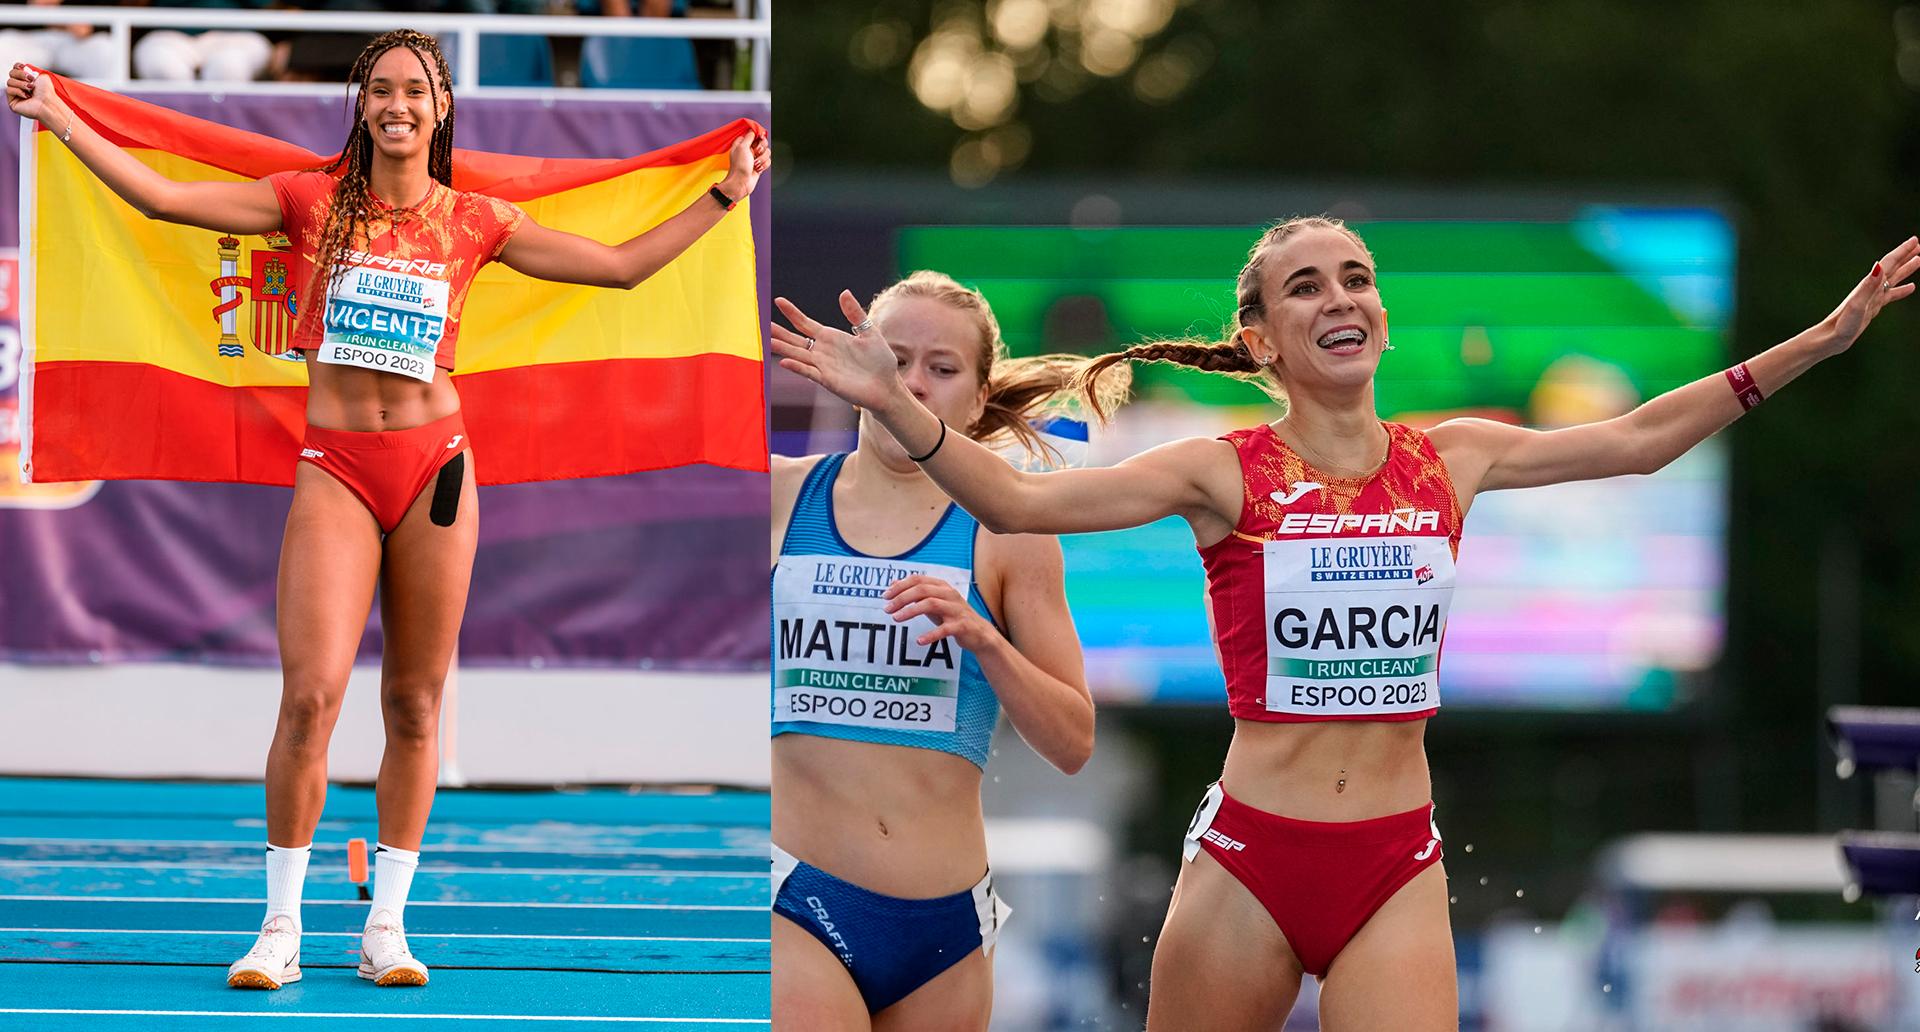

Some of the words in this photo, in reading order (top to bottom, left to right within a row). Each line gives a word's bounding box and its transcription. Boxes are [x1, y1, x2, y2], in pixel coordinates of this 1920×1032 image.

[358, 273, 372, 287] LE
[374, 274, 424, 296] GRUYÈRE
[359, 287, 419, 302] SWITZERLAND
[330, 305, 440, 345] VICENTE
[351, 334, 376, 346] RUN
[334, 347, 387, 365] ESPOO
[390, 356, 424, 375] 2023
[1276, 508, 1440, 534] ESPAÑA
[1311, 547, 1333, 568] LE
[1336, 541, 1413, 568] GRUYÈRE
[814, 562, 836, 583] LE
[1314, 570, 1410, 580] SWITZERLAND
[816, 585, 882, 598] SWITZERL
[1273, 603, 1439, 650] GARCIA
[779, 617, 954, 670] MATTILA
[800, 670, 806, 684] I
[810, 671, 848, 688] RUN
[1317, 662, 1356, 677] RUN
[1291, 685, 1376, 707] ESPOO
[1382, 681, 1427, 705] 2023
[790, 693, 866, 718] ESPOO
[873, 700, 931, 722] 2023
[1202, 828, 1246, 851] ESP
[806, 896, 848, 950] CRAFT
